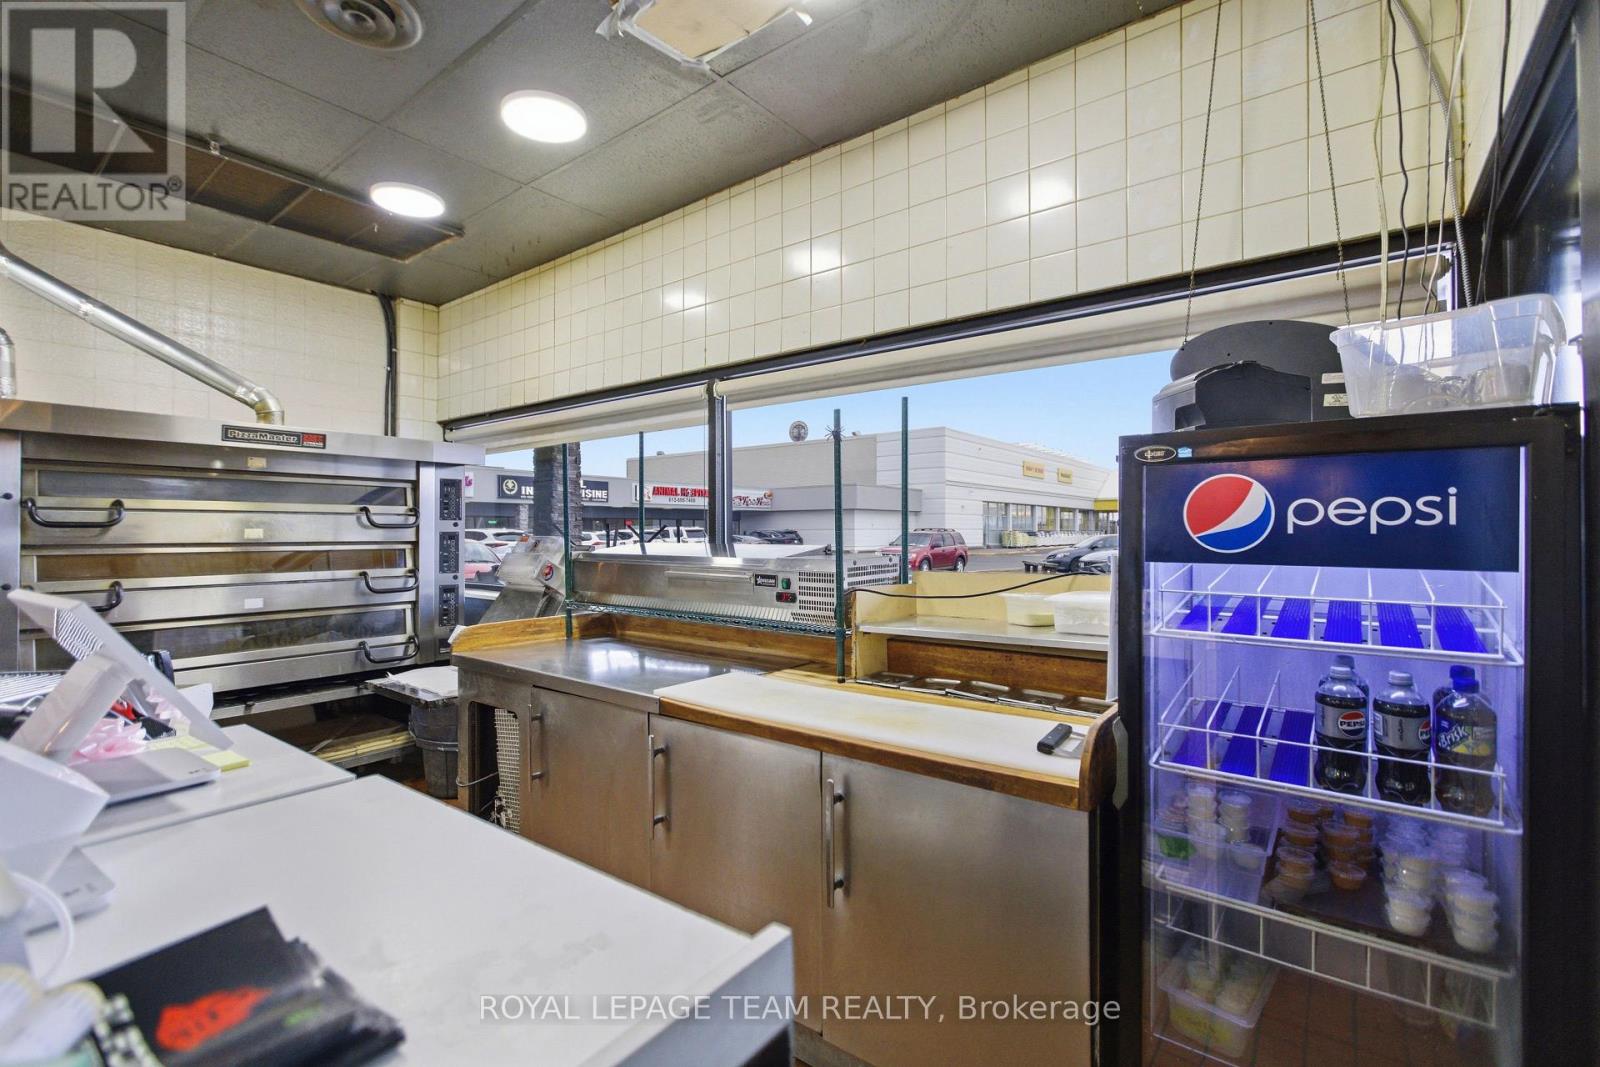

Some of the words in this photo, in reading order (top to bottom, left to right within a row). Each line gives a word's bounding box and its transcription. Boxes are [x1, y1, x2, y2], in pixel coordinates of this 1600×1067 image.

[581, 489, 608, 499] ISINE
[680, 487, 709, 497] HOSPITA
[1287, 487, 1458, 534] pepsi
